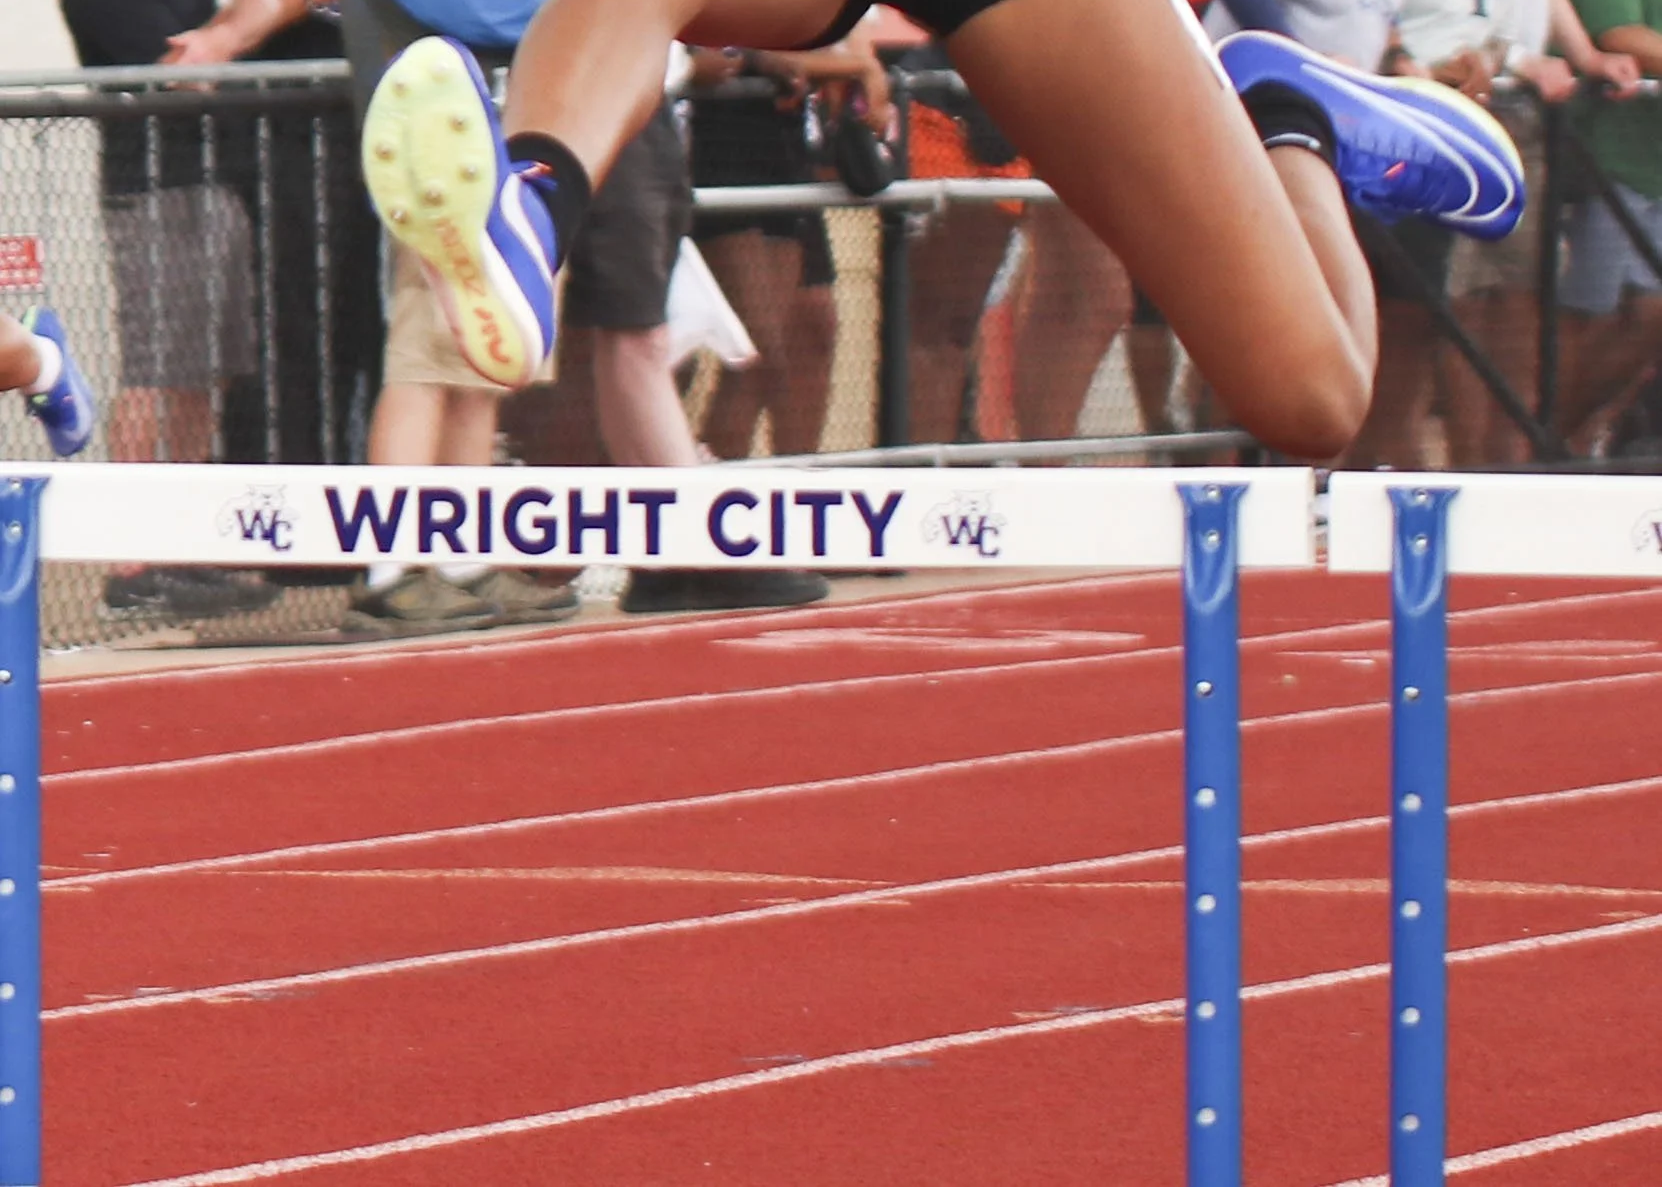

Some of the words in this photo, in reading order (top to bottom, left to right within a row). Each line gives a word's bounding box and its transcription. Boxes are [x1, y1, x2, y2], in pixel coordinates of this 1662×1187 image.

[235, 509, 293, 552] WC
[323, 485, 677, 556] WRIGHT
[706, 488, 905, 557] CITY
[941, 515, 1000, 558] WC
